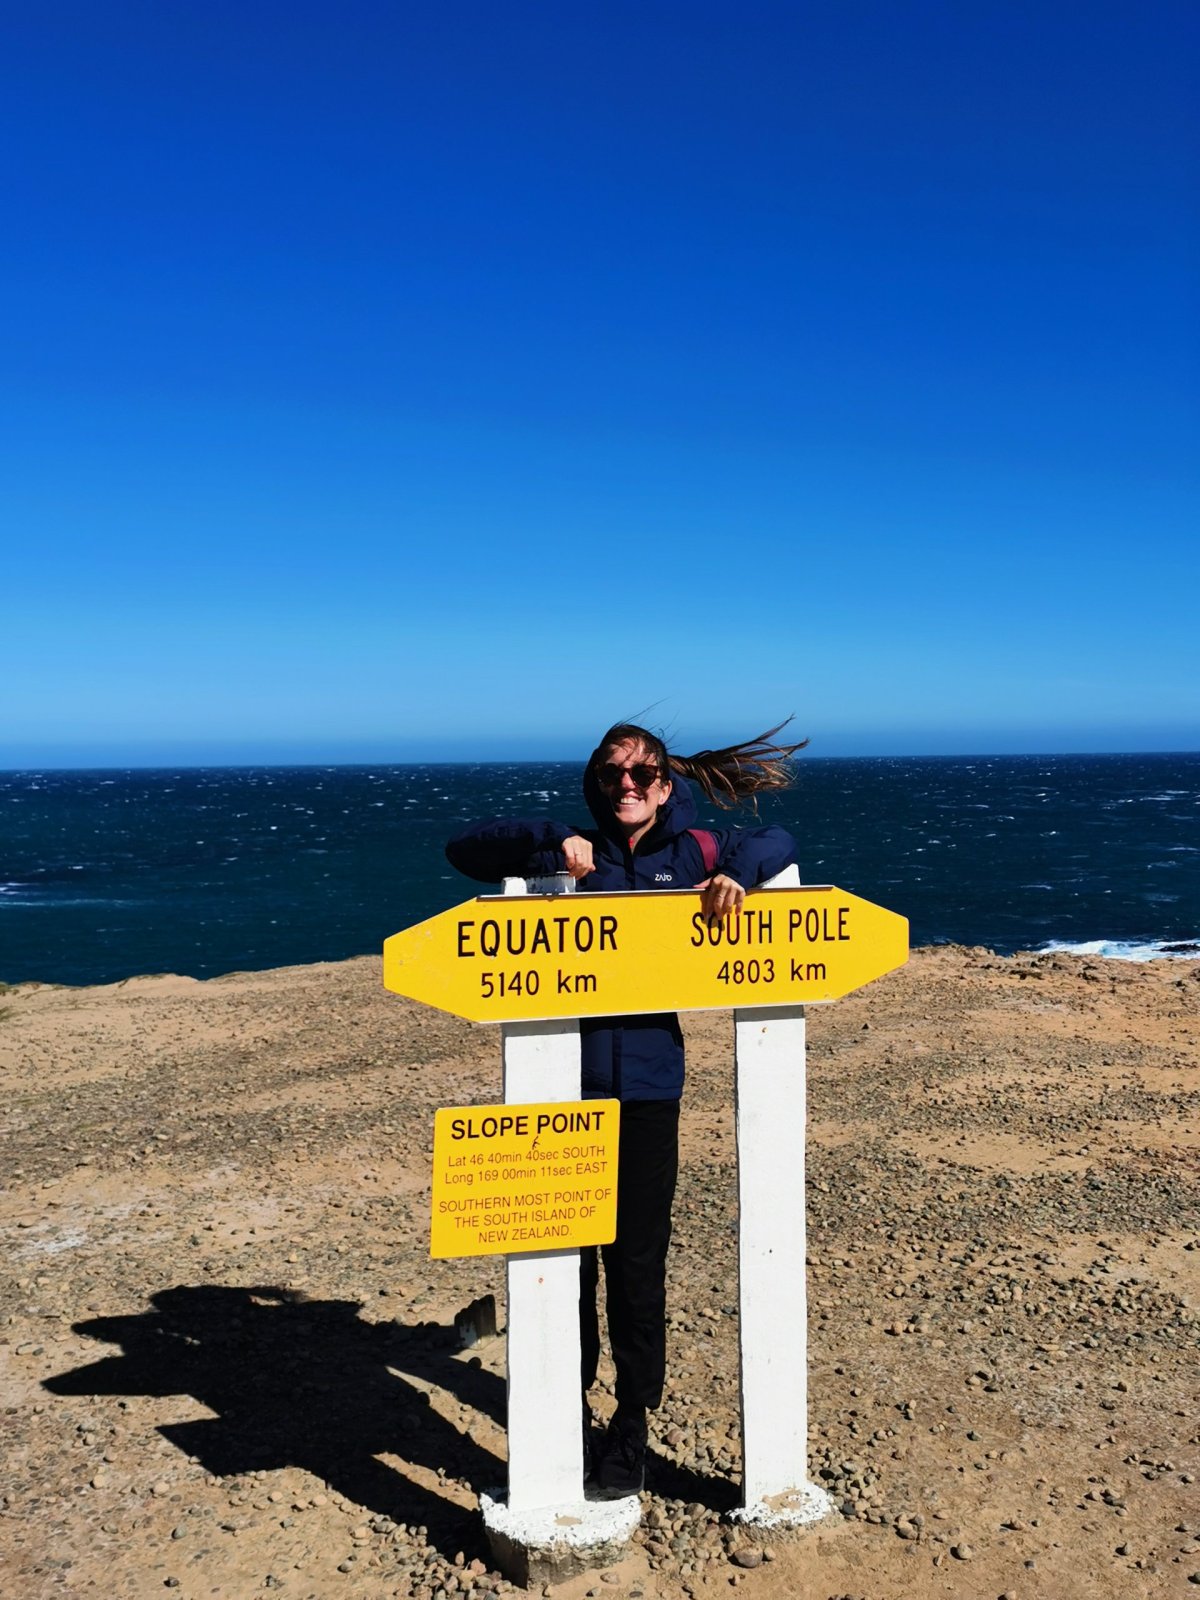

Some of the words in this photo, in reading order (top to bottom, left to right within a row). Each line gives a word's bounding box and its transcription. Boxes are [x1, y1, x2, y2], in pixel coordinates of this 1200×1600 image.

[457, 916, 619, 959] EQUATOR
[691, 910, 773, 947] SOUTH
[789, 907, 851, 943] POLE
[481, 971, 539, 998] 5140
[557, 970, 597, 994] km
[717, 959, 775, 985] 4803
[791, 958, 826, 981] km
[451, 1115, 529, 1140] SLOPE
[537, 1112, 604, 1134] POINT
[448, 1156, 466, 1167] Lat
[470, 1154, 483, 1165] 46
[488, 1151, 522, 1164] 40min
[526, 1150, 559, 1161] 40sec
[563, 1146, 605, 1159] SOUTH
[446, 1173, 473, 1185] Long
[479, 1170, 498, 1182] 169
[502, 1167, 536, 1181] 00min
[542, 1166, 572, 1177] 11sec
[576, 1162, 608, 1174] EAST
[439, 1194, 511, 1213] SOUTHERN
[515, 1192, 551, 1207] MOST
[555, 1190, 591, 1203] POINT
[595, 1188, 612, 1200] OF
[455, 1216, 479, 1228] THE
[484, 1211, 528, 1226] SOUTH
[532, 1208, 575, 1222] ISLAND
[580, 1206, 596, 1217] OF
[479, 1229, 508, 1243] NEW
[512, 1225, 572, 1241] ZEALAND.
